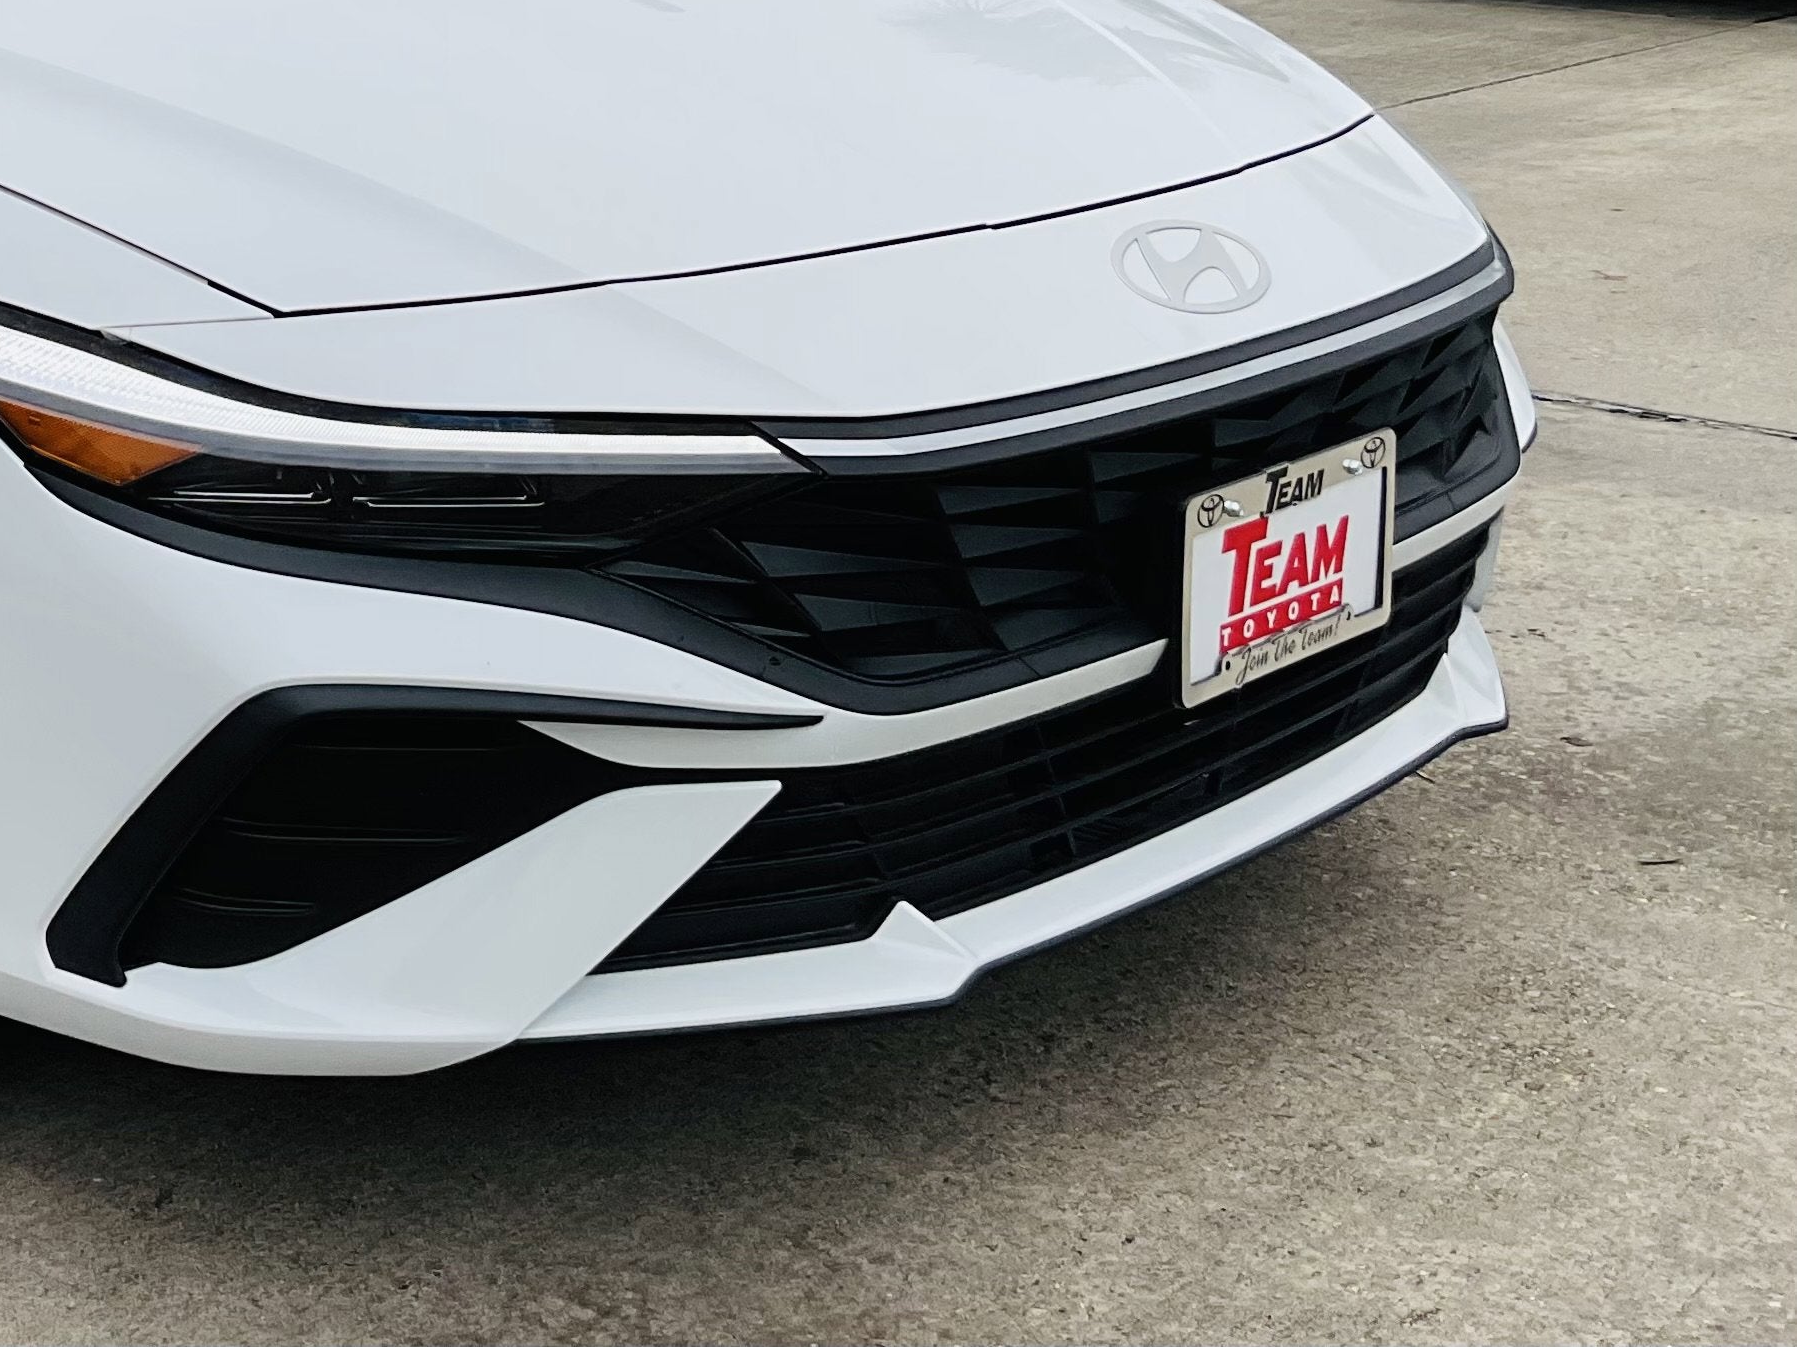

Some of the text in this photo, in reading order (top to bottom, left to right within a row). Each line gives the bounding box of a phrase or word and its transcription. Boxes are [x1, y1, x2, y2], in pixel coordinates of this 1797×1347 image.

[1265, 465, 1325, 515] TEAM
[1221, 514, 1349, 617] TEAM
[1221, 584, 1340, 647] TOYOTA
[1235, 646, 1269, 686] Join
